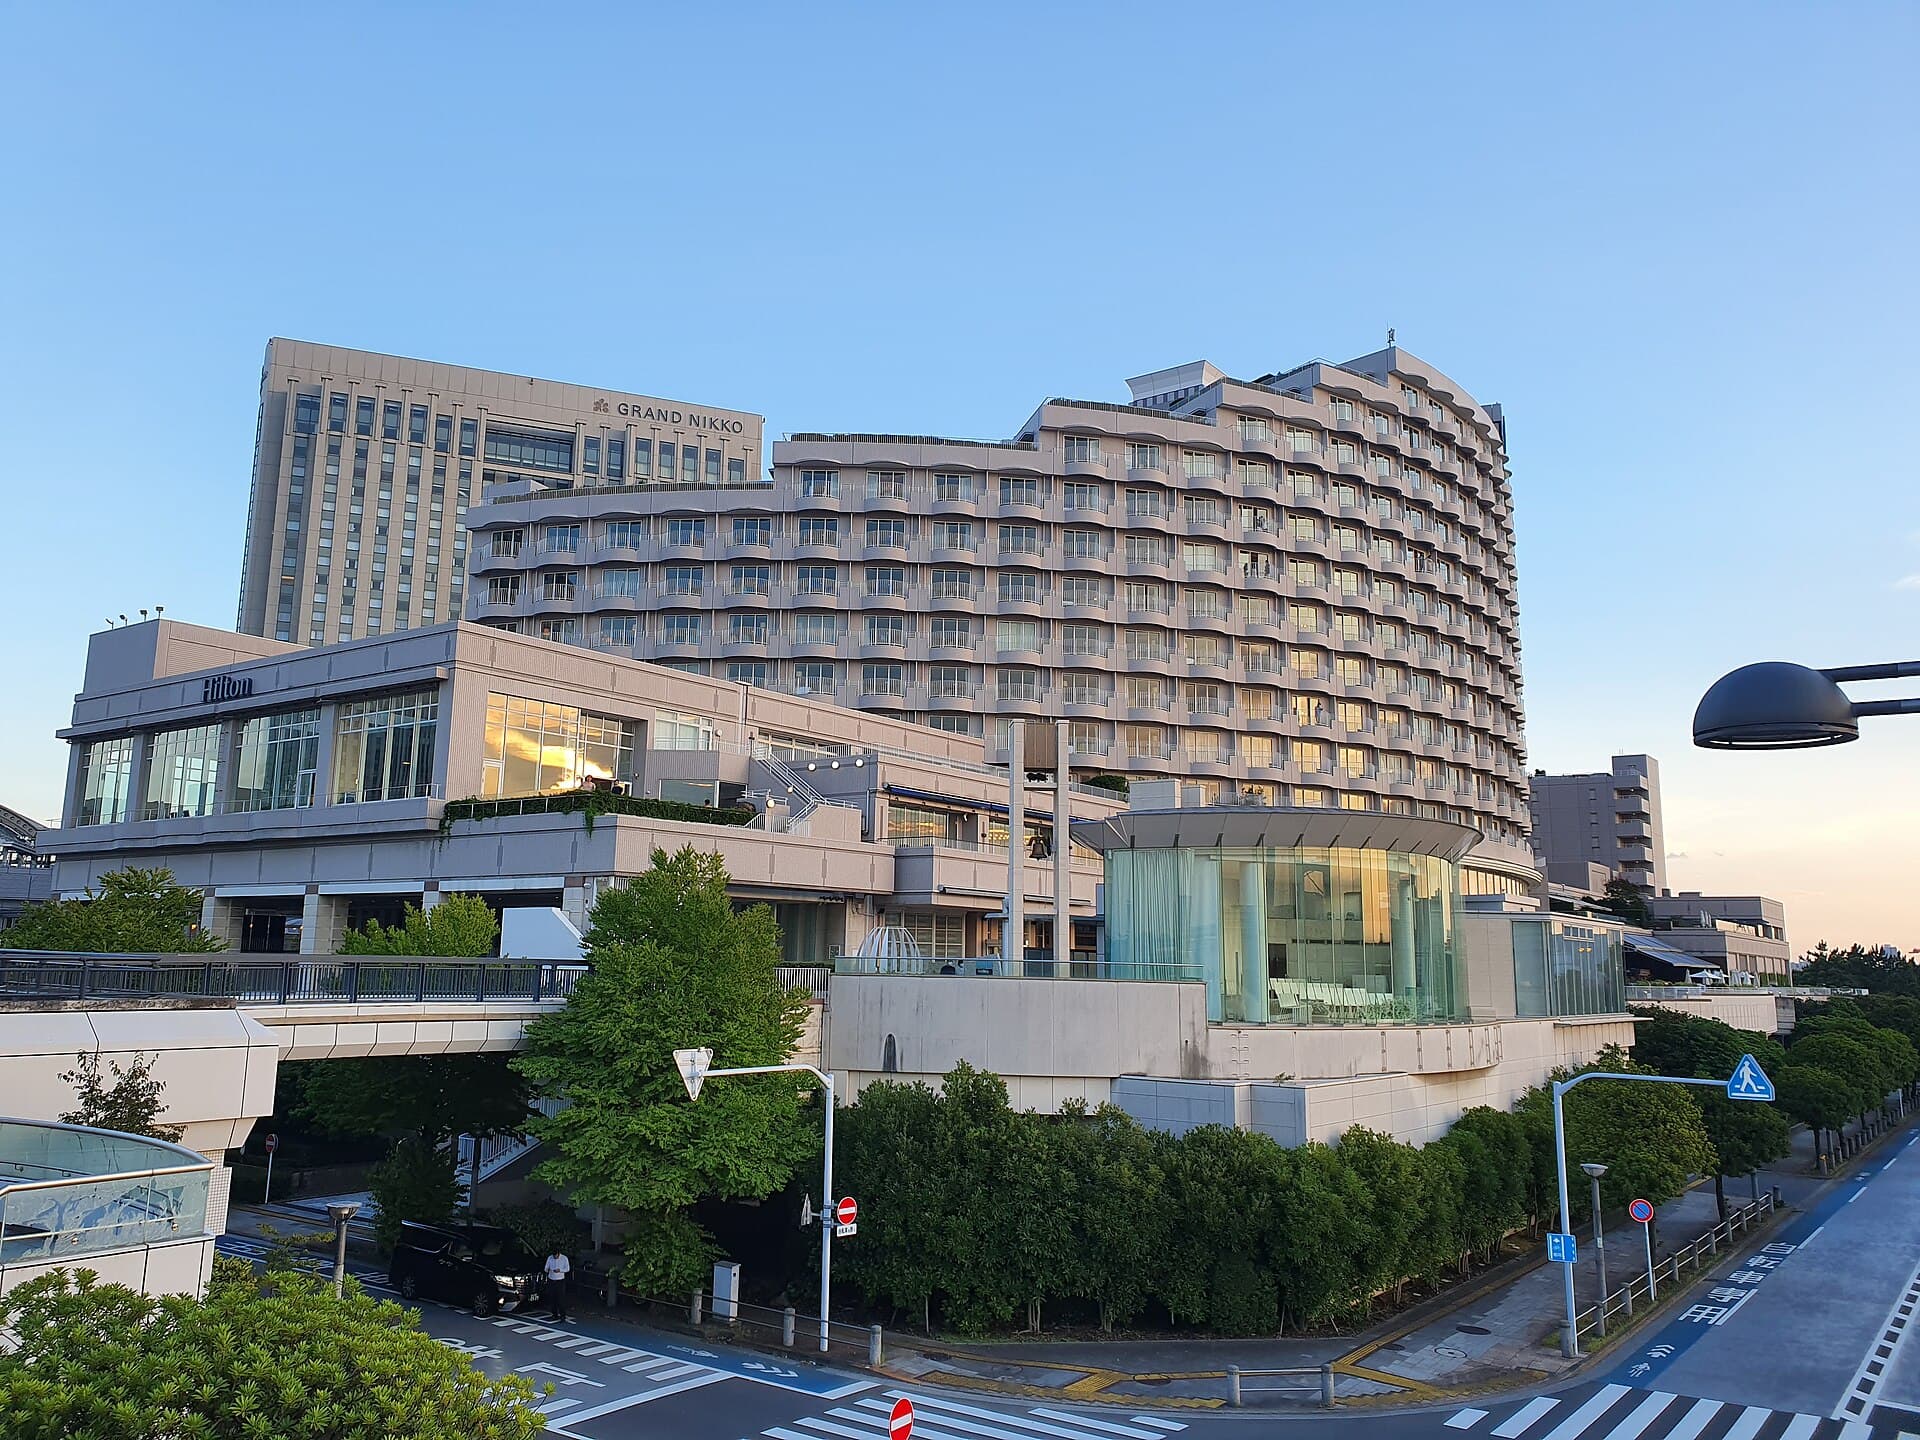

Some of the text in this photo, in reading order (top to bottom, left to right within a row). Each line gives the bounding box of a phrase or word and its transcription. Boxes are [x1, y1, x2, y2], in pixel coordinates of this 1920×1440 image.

[617, 402, 744, 434] GRAND NIKKO
[201, 674, 253, 701] Hilton
